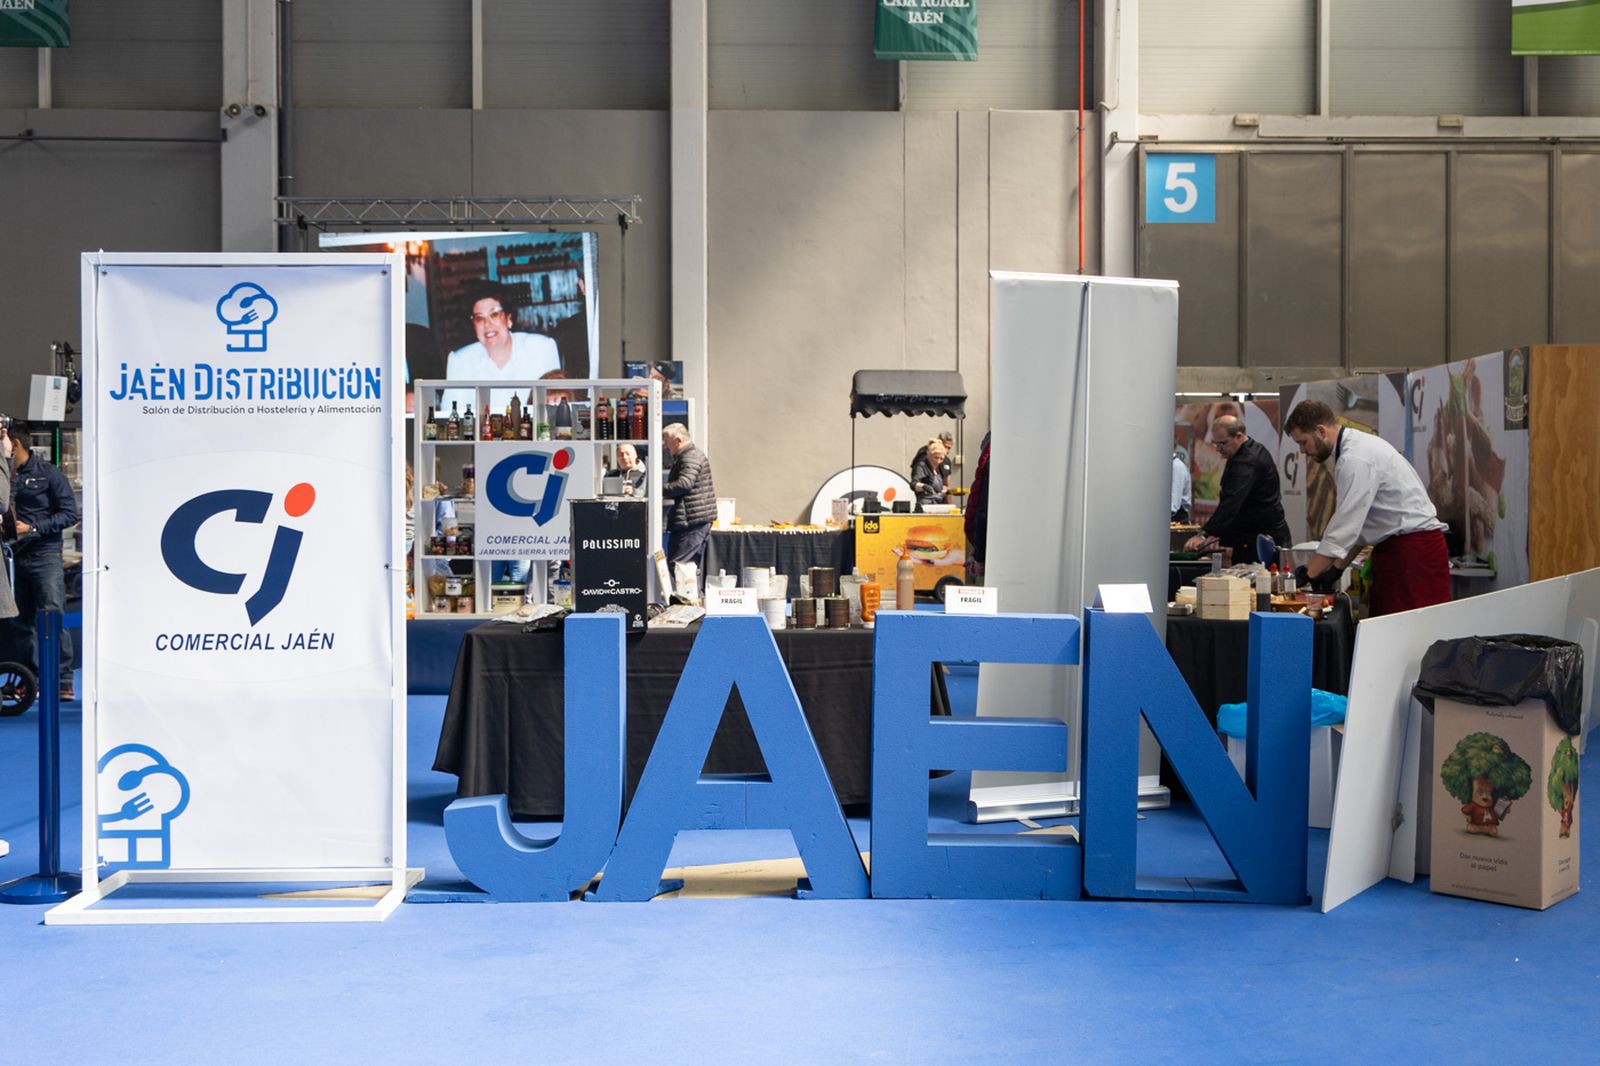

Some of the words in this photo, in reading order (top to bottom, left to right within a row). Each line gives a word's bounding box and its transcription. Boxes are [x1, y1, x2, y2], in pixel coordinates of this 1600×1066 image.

[1163, 162, 1198, 214] 5
[142, 405, 170, 415] Salón
[171, 405, 186, 415] de
[188, 404, 245, 414] Distribución
[247, 406, 255, 414] a
[308, 406, 316, 416] y
[317, 403, 382, 414] Alimentación
[486, 535, 551, 545] COMERCIAL
[553, 535, 571, 545] JA
[478, 548, 516, 556] JAMONES
[518, 548, 546, 556] SIERRA
[155, 633, 275, 652] COMERCIAL
[281, 628, 335, 651] JAÉN
[445, 608, 1313, 905] JAEN
